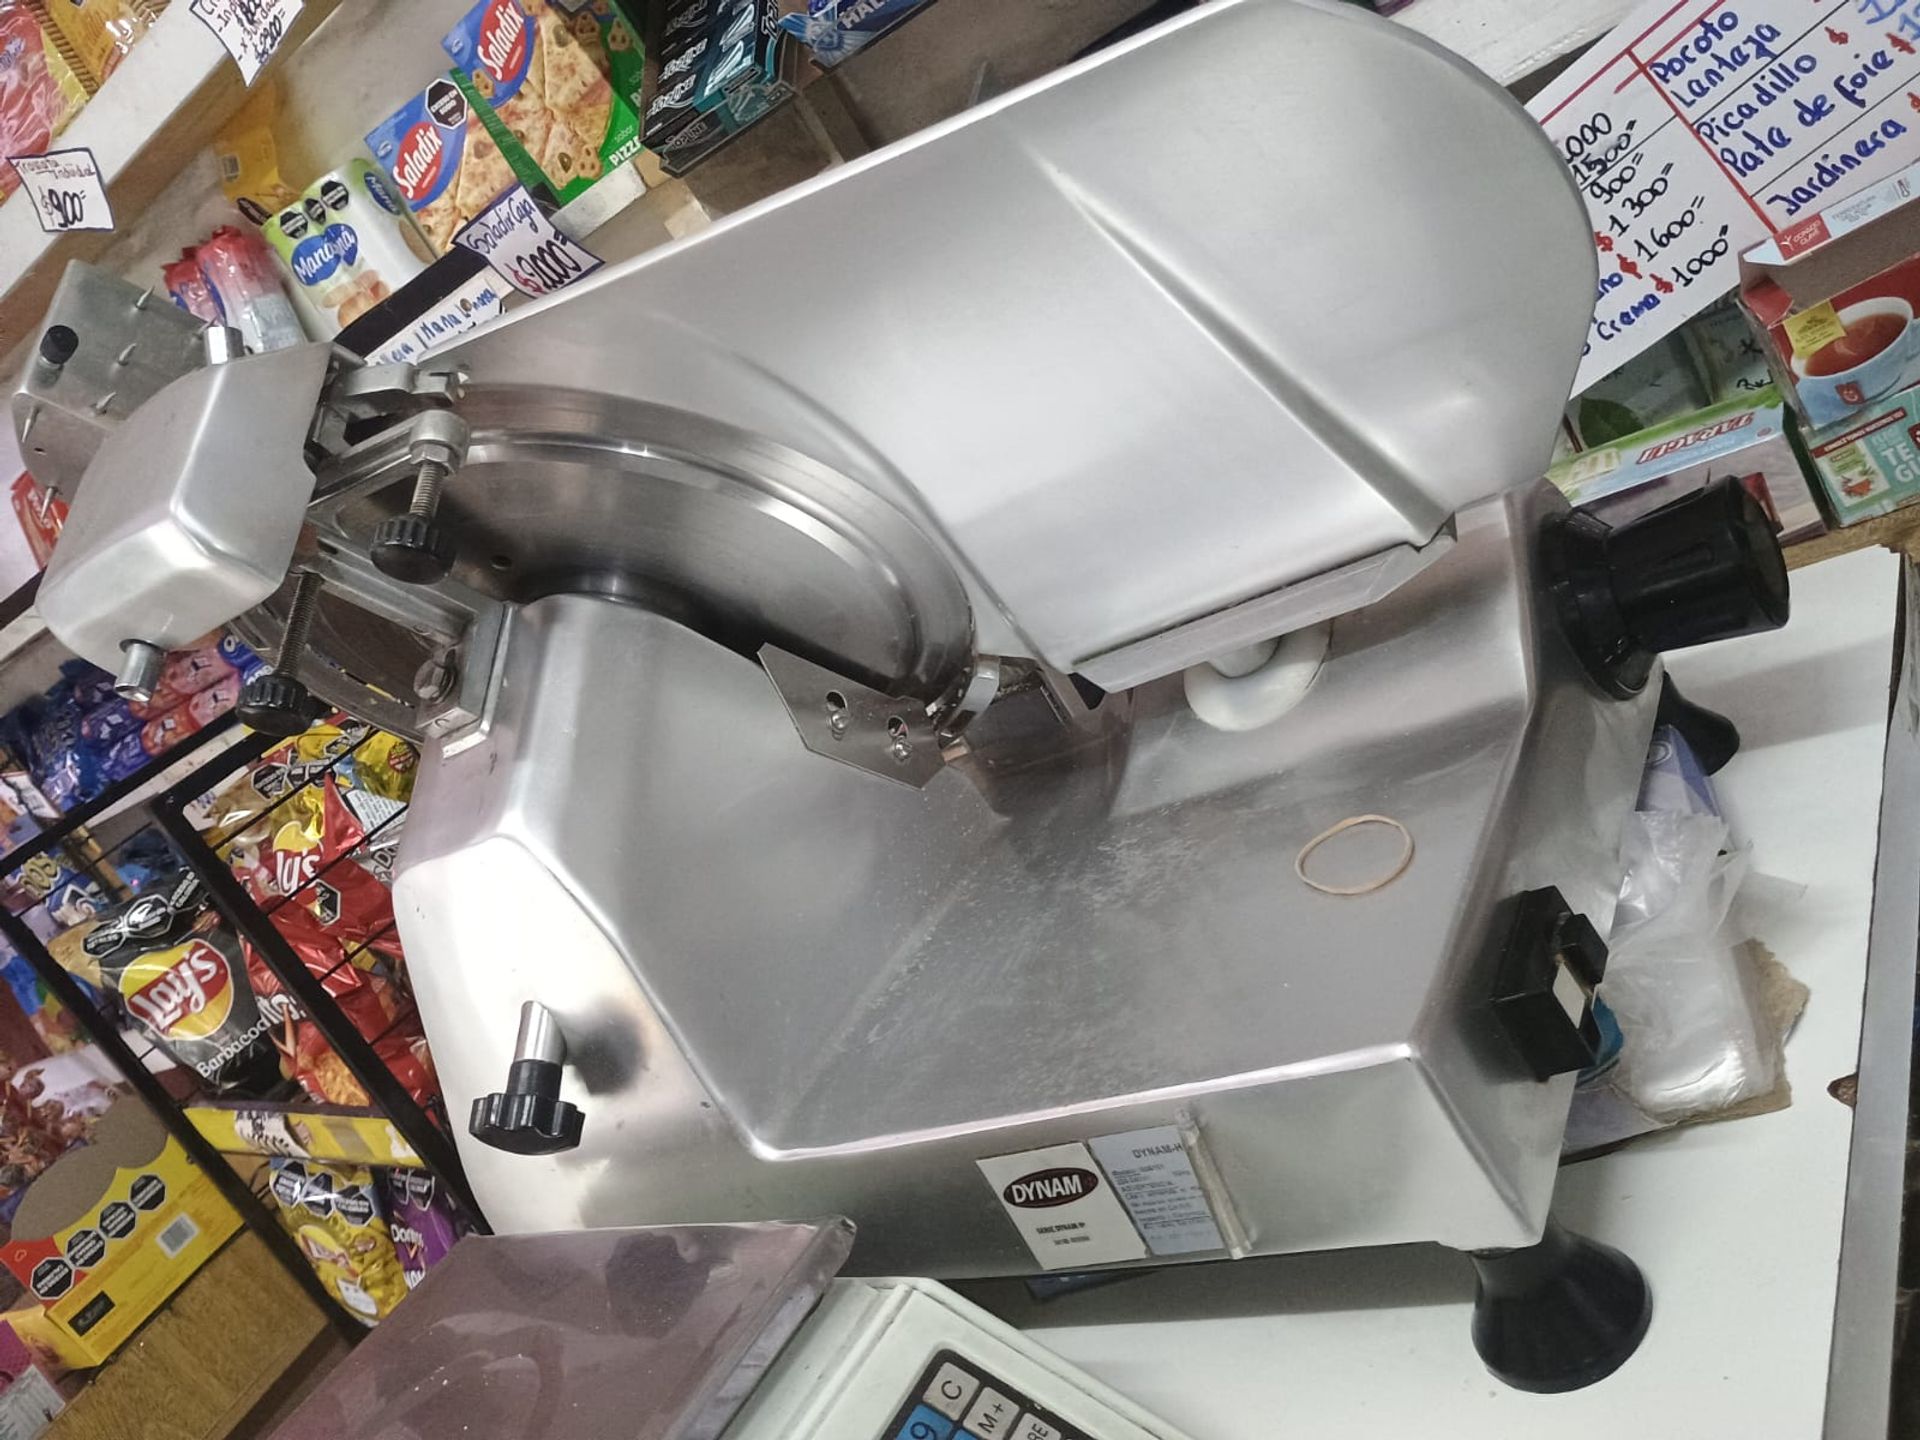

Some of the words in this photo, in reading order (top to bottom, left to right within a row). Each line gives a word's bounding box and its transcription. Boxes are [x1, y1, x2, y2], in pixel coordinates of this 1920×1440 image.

[477, 1, 524, 81] Saladix
[1698, 54, 1817, 145] Picadillo
[1798, 94, 1835, 128] de
[393, 125, 443, 199] Saladix
[1563, 112, 1613, 164] 000
[1767, 118, 1907, 216] Jardinera
[466, 207, 516, 254] Saladix
[512, 197, 536, 233] Caja
[1597, 293, 1661, 341] Crema
[130, 948, 218, 1030] Lay's
[1011, 1174, 1083, 1204] DYNAM
[941, 1379, 962, 1400] C
[910, 1421, 938, 1440] 9
[977, 1402, 1005, 1434] M+
